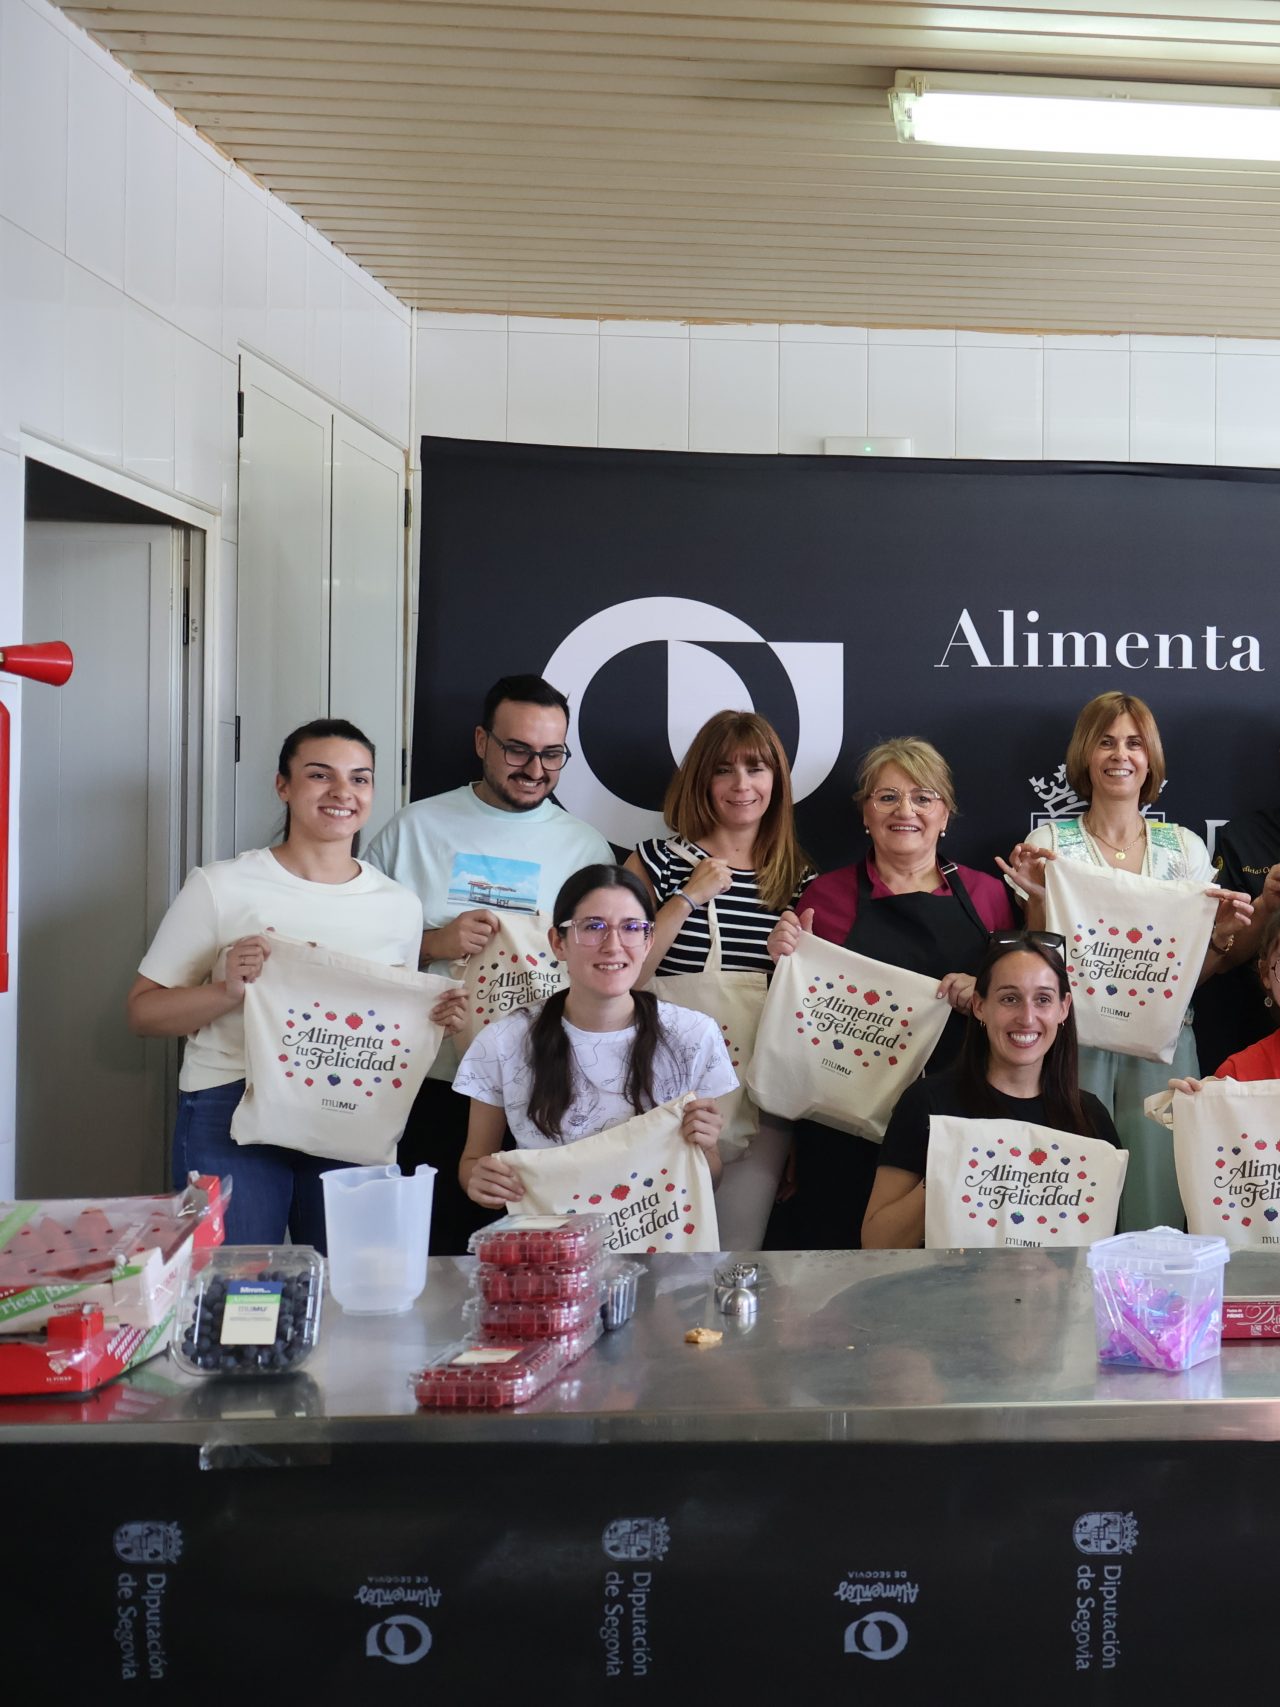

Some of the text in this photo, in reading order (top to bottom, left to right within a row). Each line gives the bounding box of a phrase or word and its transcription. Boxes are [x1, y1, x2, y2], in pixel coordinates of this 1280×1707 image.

[934, 608, 1266, 672] Alimenta
[1070, 941, 1160, 963] Alimenta
[477, 970, 561, 1000] Alimenta
[1081, 957, 1170, 982] tu Felicidad
[488, 985, 557, 1011] tu Felicid
[803, 996, 894, 1028] Alimenta
[282, 1027, 384, 1050] Alimenta
[811, 1009, 900, 1048] tu Felicidad
[296, 1045, 396, 1071] tu Felicidad
[965, 1164, 1069, 1188] Alimenta
[1229, 1184, 1242, 1195] tu
[608, 1192, 660, 1227] menta
[978, 1184, 1082, 1209] tu Felicidad
[114, 1573, 139, 1679] de Segovia
[141, 1573, 167, 1679] Diputación
[600, 1571, 624, 1676] de Segovia
[627, 1572, 652, 1676] Diputación
[1071, 1565, 1096, 1671] de Segovia
[1099, 1565, 1121, 1669] Diputación
